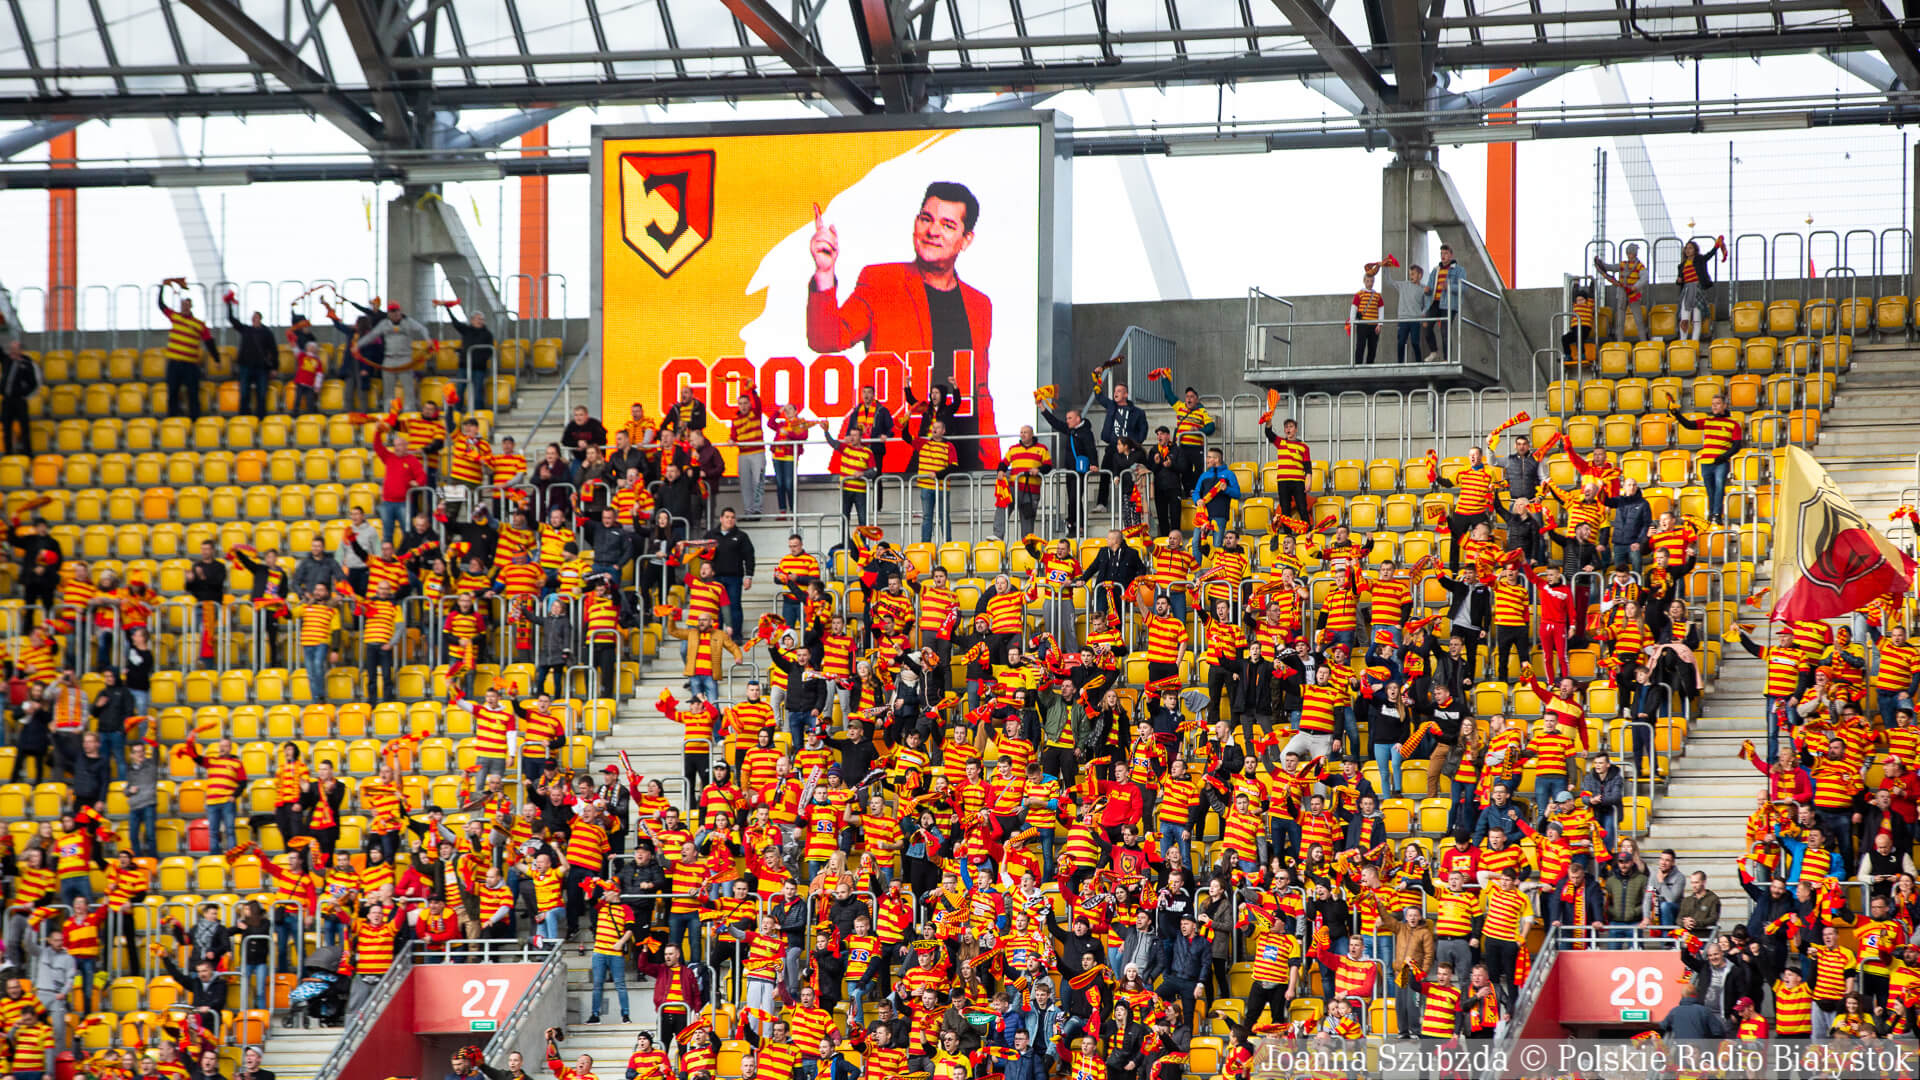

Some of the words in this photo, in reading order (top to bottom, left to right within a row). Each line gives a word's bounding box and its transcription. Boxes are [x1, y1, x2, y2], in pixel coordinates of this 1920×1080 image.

[1050, 570, 1067, 582] STS
[817, 821, 833, 832] STS
[851, 949, 869, 961] STS
[1610, 966, 1664, 1006] 26
[461, 979, 510, 1018] 27
